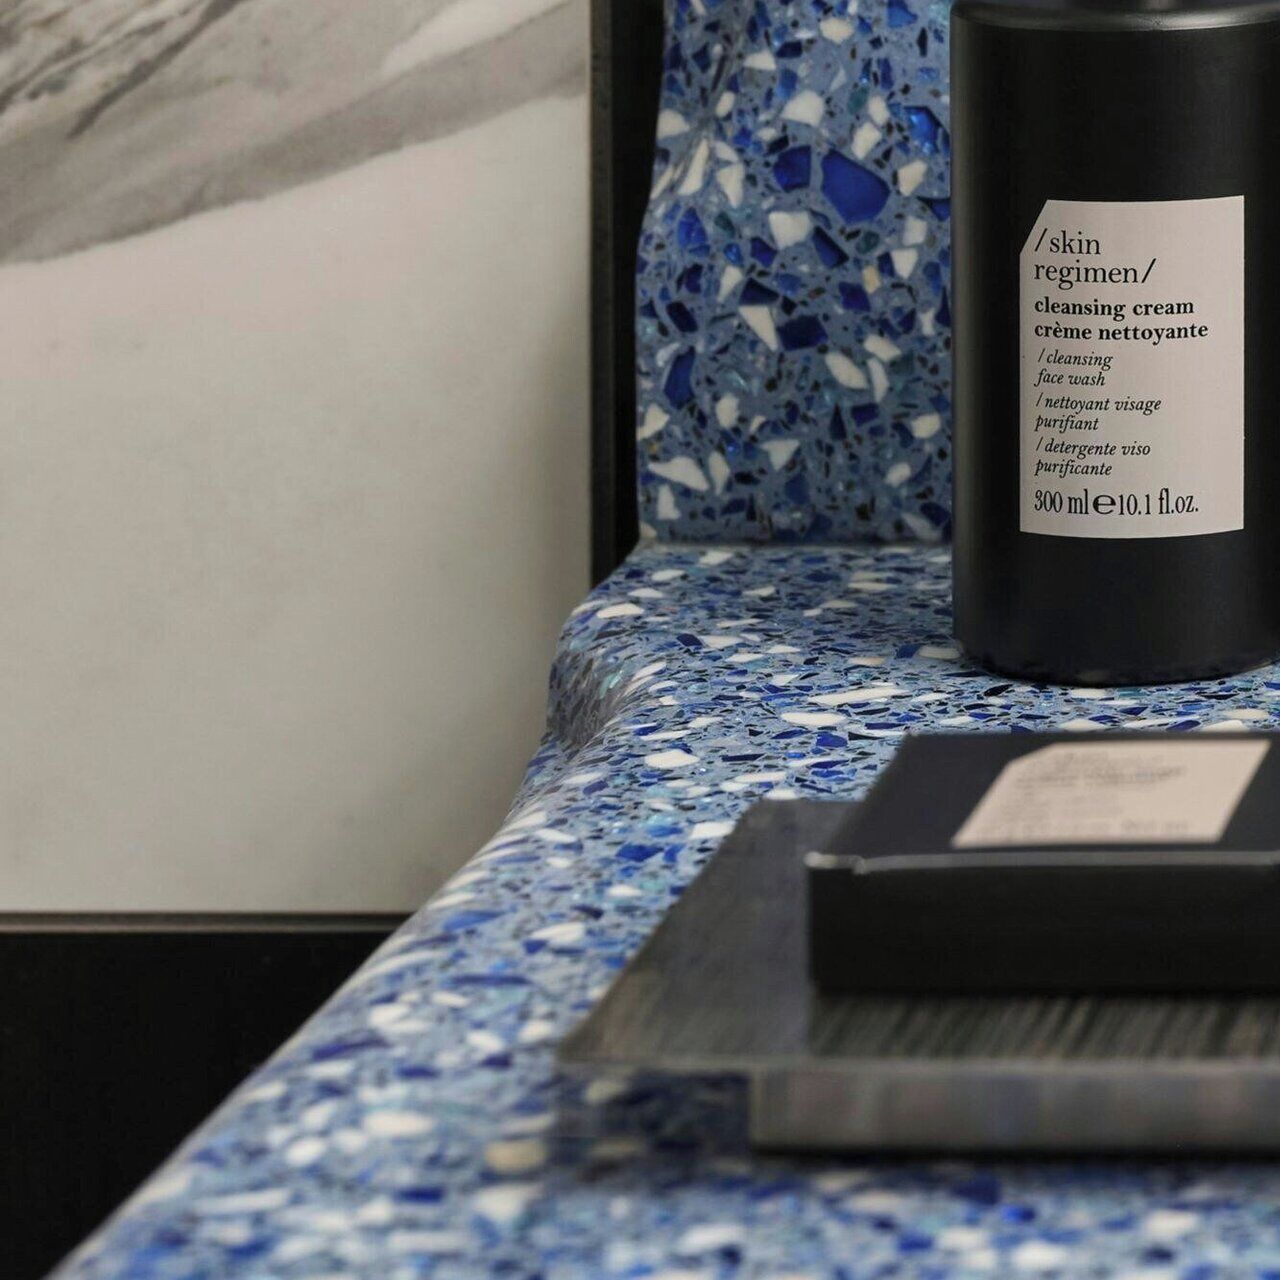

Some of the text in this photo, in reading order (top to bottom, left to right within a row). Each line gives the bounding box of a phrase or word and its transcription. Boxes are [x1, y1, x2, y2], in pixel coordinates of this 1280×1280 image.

[1033, 257, 1157, 291] regimen/
[1034, 295, 1195, 322] cleansing cream
[1034, 320, 1209, 346] crème nettoyante
[1033, 369, 1106, 388] face wash
[1114, 399, 1162, 413] visage
[1033, 414, 1099, 433] purifiant
[1120, 444, 1151, 456] viso
[1033, 458, 1113, 479] purificante
[1034, 490, 1064, 514] 300
